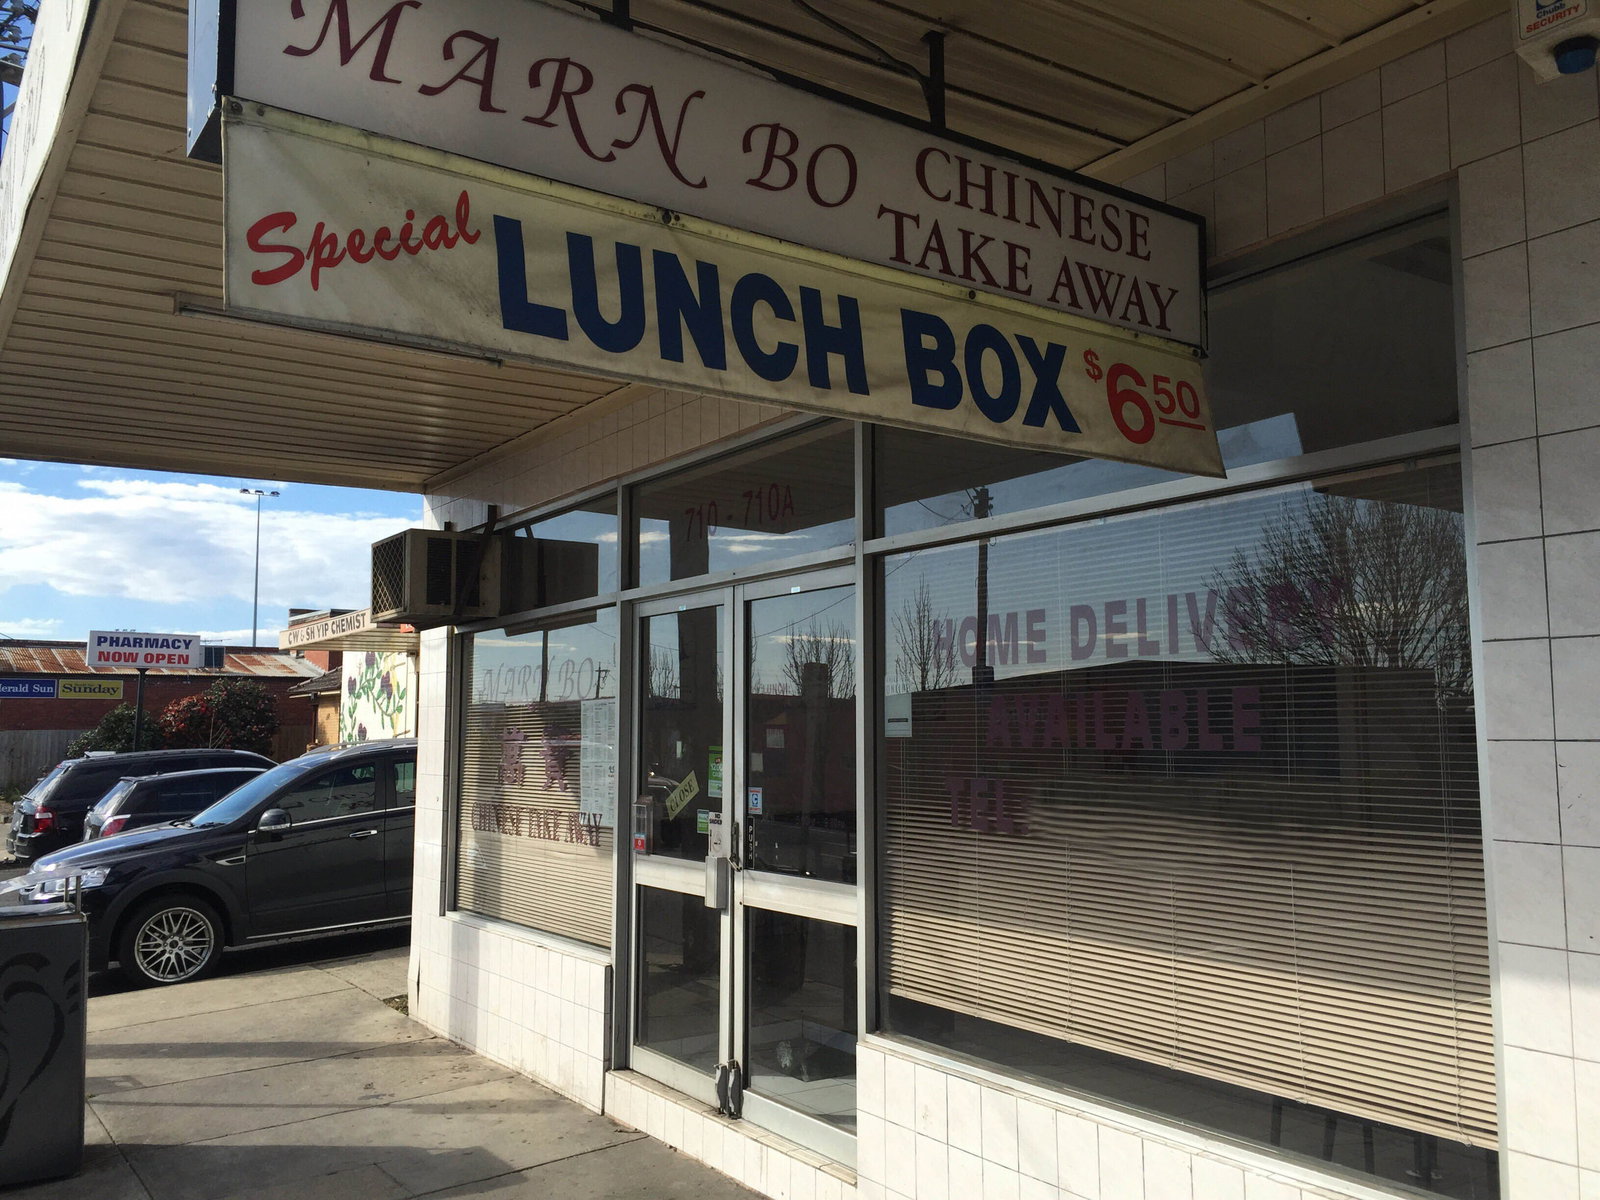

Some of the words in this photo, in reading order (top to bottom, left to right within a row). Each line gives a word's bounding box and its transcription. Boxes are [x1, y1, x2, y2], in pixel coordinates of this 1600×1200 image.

[1526, 4, 1580, 33] SECURITY
[1536, 3, 1566, 19] Chubb
[282, 0, 708, 190] MARN
[742, 122, 858, 208] BO
[915, 146, 1152, 262] CHINESE
[877, 204, 1033, 297] TAKE
[1046, 256, 1179, 332] AWAY
[246, 190, 481, 292] Special
[493, 214, 870, 396] LUNCH
[900, 308, 1082, 434] BOX
[684, 500, 718, 542] 710
[742, 483, 795, 527] 710A
[96, 635, 193, 650] PHARMACY
[287, 630, 300, 646] CW
[305, 628, 316, 642] SH
[316, 623, 330, 639] YIP
[330, 612, 367, 636] CHEMIST
[932, 608, 1047, 670] HOME
[1069, 579, 1345, 662] DELIVERY
[97, 650, 140, 664] NOW
[143, 652, 190, 665] OPEN
[32, 683, 54, 693] Sun
[61, 683, 120, 696] Sunday
[554, 657, 594, 701] BO
[985, 685, 1262, 752] AVAILABLE
[670, 778, 695, 812] CLOSE
